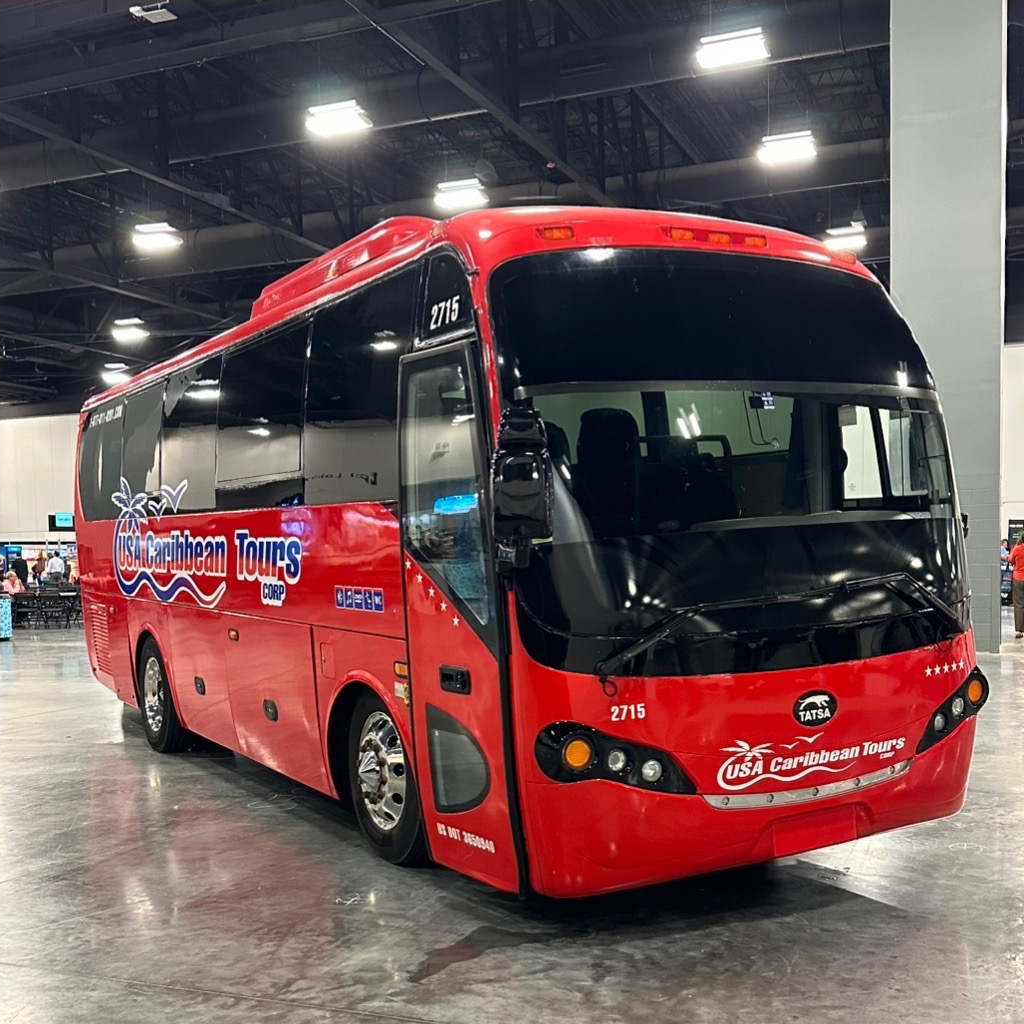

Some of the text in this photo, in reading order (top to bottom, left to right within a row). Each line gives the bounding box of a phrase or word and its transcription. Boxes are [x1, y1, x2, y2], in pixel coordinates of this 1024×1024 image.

[429, 295, 460, 331] 2715
[118, 529, 302, 583] USA Caribbean Tours
[262, 582, 285, 603] CORP
[610, 702, 646, 722] 2715
[798, 708, 832, 722] TATSA
[726, 736, 906, 780] USA Caribbean Tours
[436, 822, 447, 836] US
